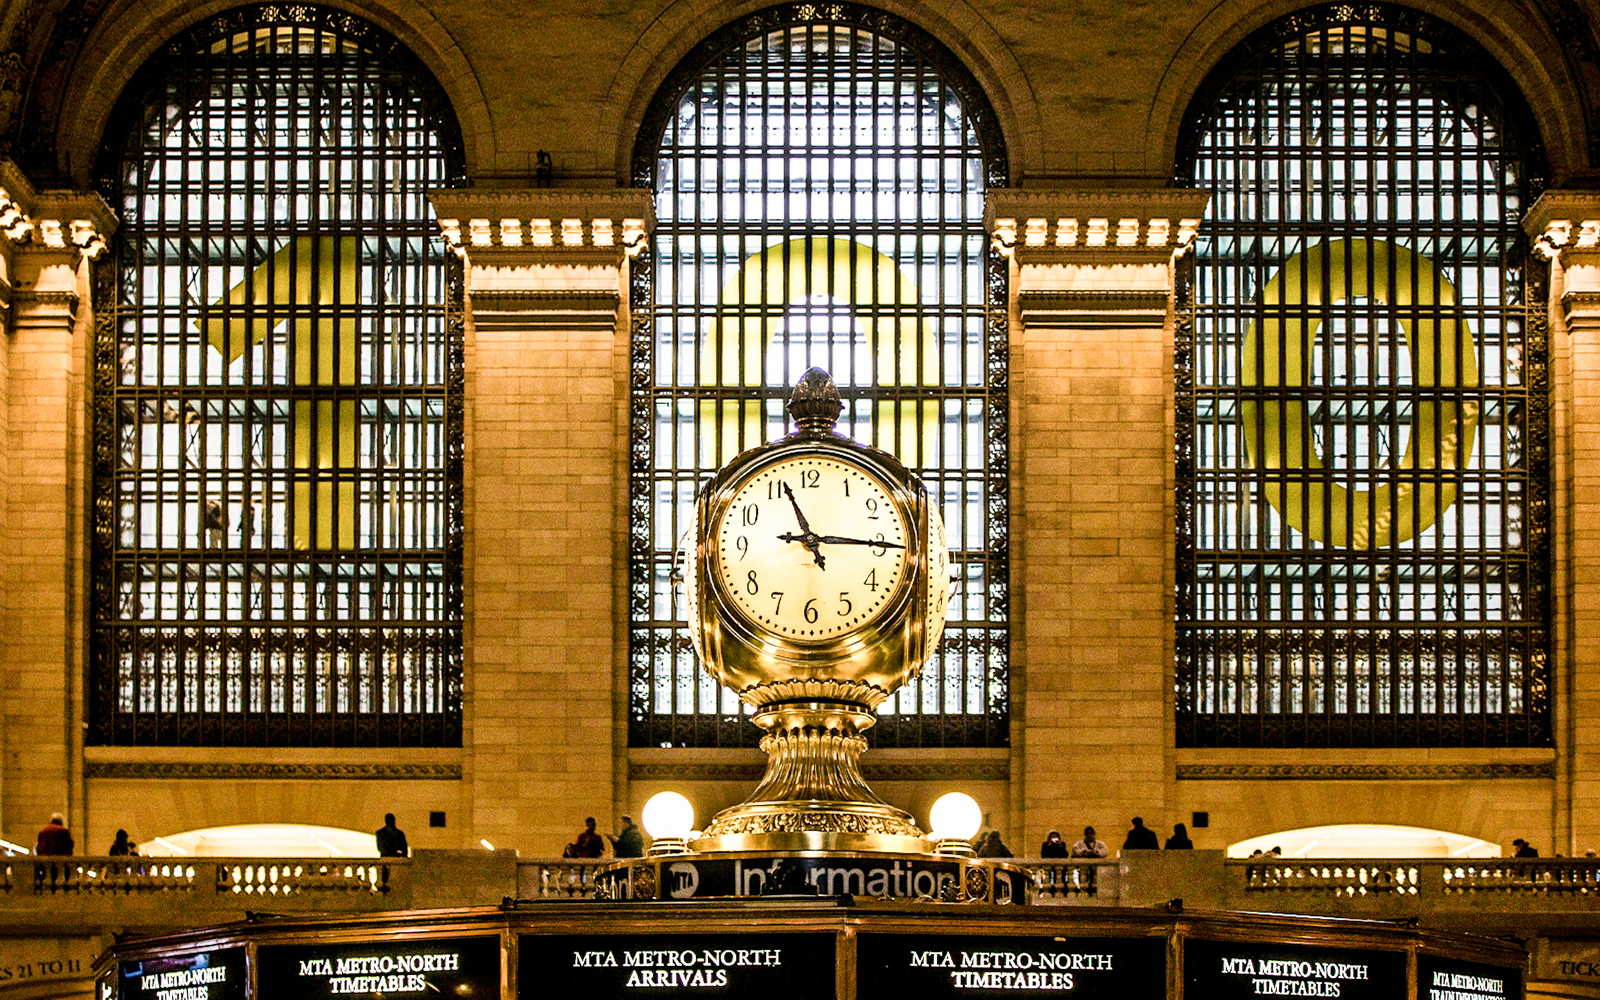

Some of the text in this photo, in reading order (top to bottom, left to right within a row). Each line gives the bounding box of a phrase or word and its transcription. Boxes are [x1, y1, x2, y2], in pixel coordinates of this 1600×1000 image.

[767, 479, 782, 500] 11
[800, 469, 820, 489] 12
[843, 477, 850, 497] 1
[742, 503, 759, 527] 10
[865, 498, 879, 520] 2
[736, 535, 749, 561] 9
[872, 533, 887, 557] 3
[746, 569, 759, 596] 8
[863, 568, 880, 592] 4
[770, 591, 784, 616] 7
[803, 598, 819, 625] 6
[836, 591, 852, 617] 5
[735, 858, 956, 898] Infrmation
[37, 960, 63, 975] TO
[299, 954, 459, 976] MTA METRO-NORTH
[573, 949, 781, 968] MTA METRO-NORTH
[910, 951, 1113, 970] MTA METRO-NORTH
[1221, 958, 1368, 980] MTA METRO-NORTH
[1559, 961, 1600, 976] TICK
[141, 966, 226, 990] MTA METRO-NORTH
[329, 974, 426, 994] TIMETABLES
[626, 969, 727, 987] ARRIVALS
[951, 971, 1074, 989] TIMETABLES
[1252, 978, 1340, 998] TIMETABLES
[1433, 971, 1503, 993] MTA METRO-NORTH
